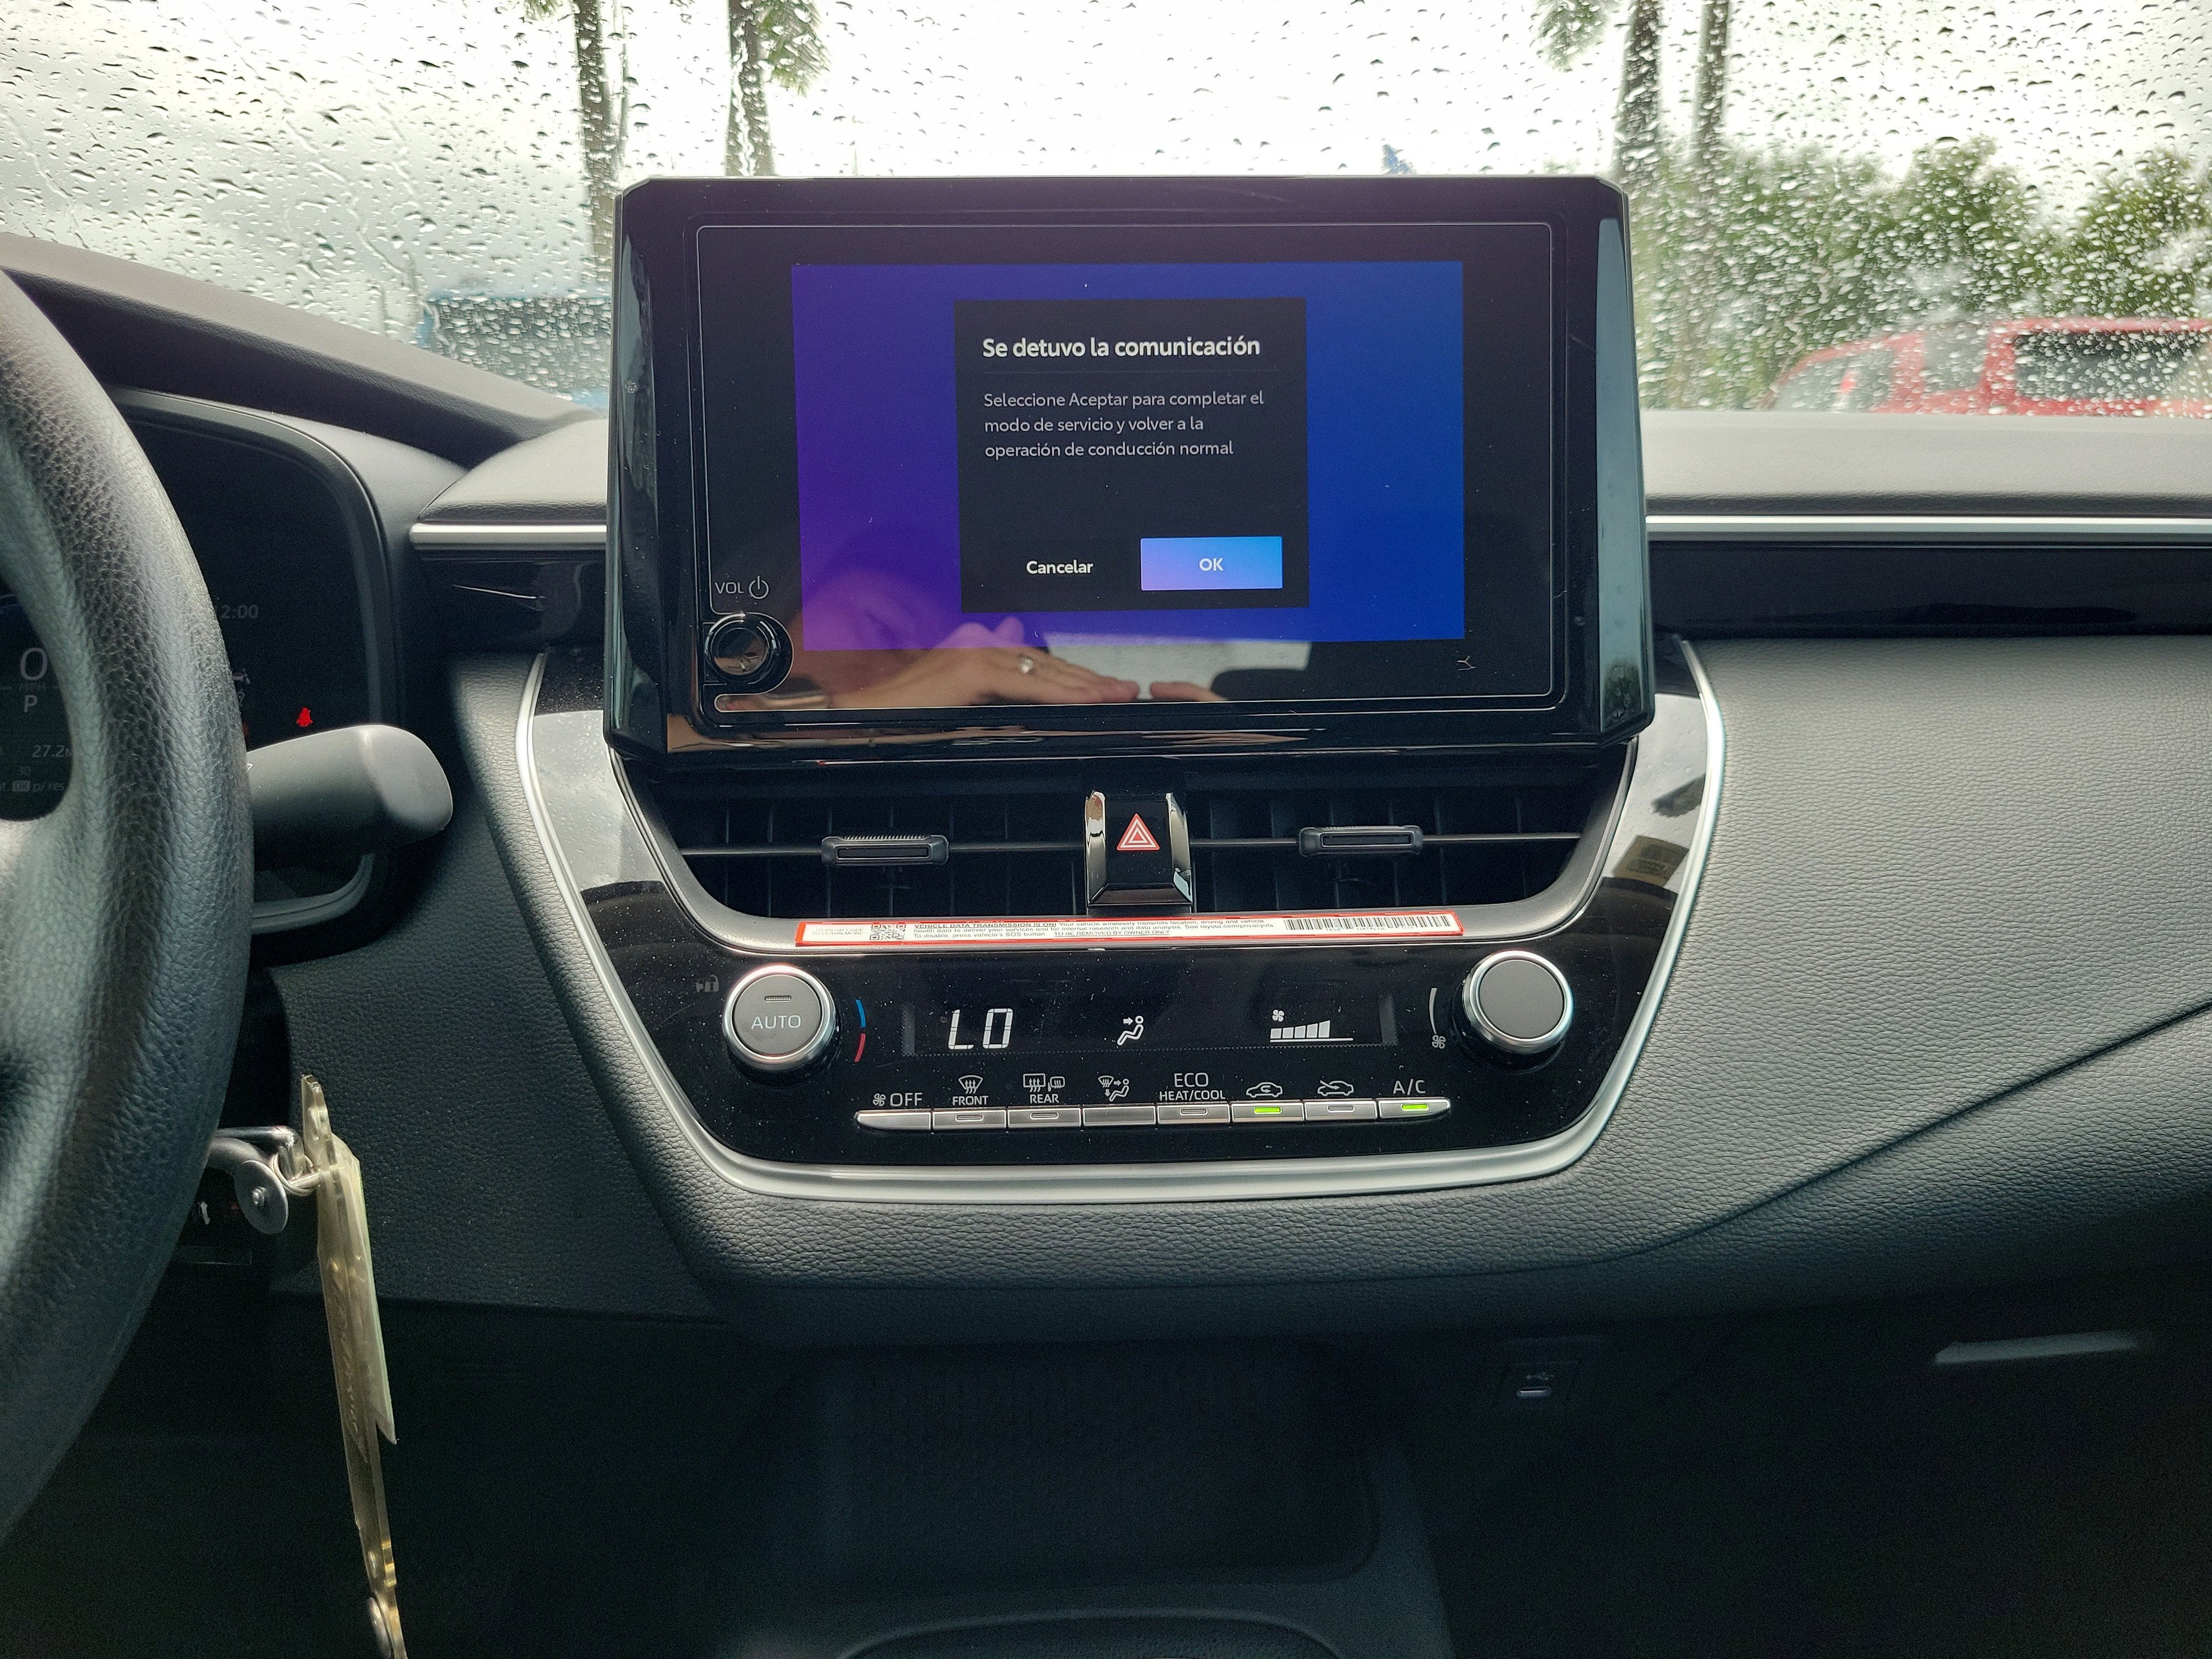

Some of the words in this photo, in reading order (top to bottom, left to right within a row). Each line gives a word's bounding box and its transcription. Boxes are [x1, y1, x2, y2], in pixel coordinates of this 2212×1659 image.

[982, 338, 1008, 357] Se
[1012, 338, 1086, 357] detuvo
[1090, 337, 1109, 357] la
[1114, 336, 1261, 356] comunicación
[984, 393, 1065, 408] Seleccione
[1069, 392, 1128, 410] Aceptar
[1132, 394, 1165, 409] para
[1169, 392, 1246, 409] completar
[1250, 391, 1264, 405] el
[985, 418, 1030, 432] modo
[1034, 417, 1053, 432] de
[1057, 417, 1114, 431] servicio
[1115, 420, 1126, 435] y
[1128, 417, 1174, 431] volver
[1177, 420, 1186, 431] a
[1190, 416, 1204, 431] la
[985, 443, 1060, 461] operación
[1064, 443, 1085, 456] de
[1087, 442, 1175, 456] conducción
[1180, 441, 1234, 455] normal
[1025, 559, 1094, 574] Cancelar
[1198, 557, 1224, 572] OK
[715, 582, 744, 594] VOL
[216, 604, 259, 619] 2:00
[24, 694, 38, 713] P
[751, 1015, 802, 1029] AUTO
[1173, 1072, 1209, 1088] ECO
[1392, 1079, 1426, 1095] A/C
[889, 1092, 923, 1107] OFF
[952, 1096, 989, 1105] FRONT
[1030, 1093, 1060, 1103] REAR
[1159, 1088, 1226, 1102] HEAT/COOL
